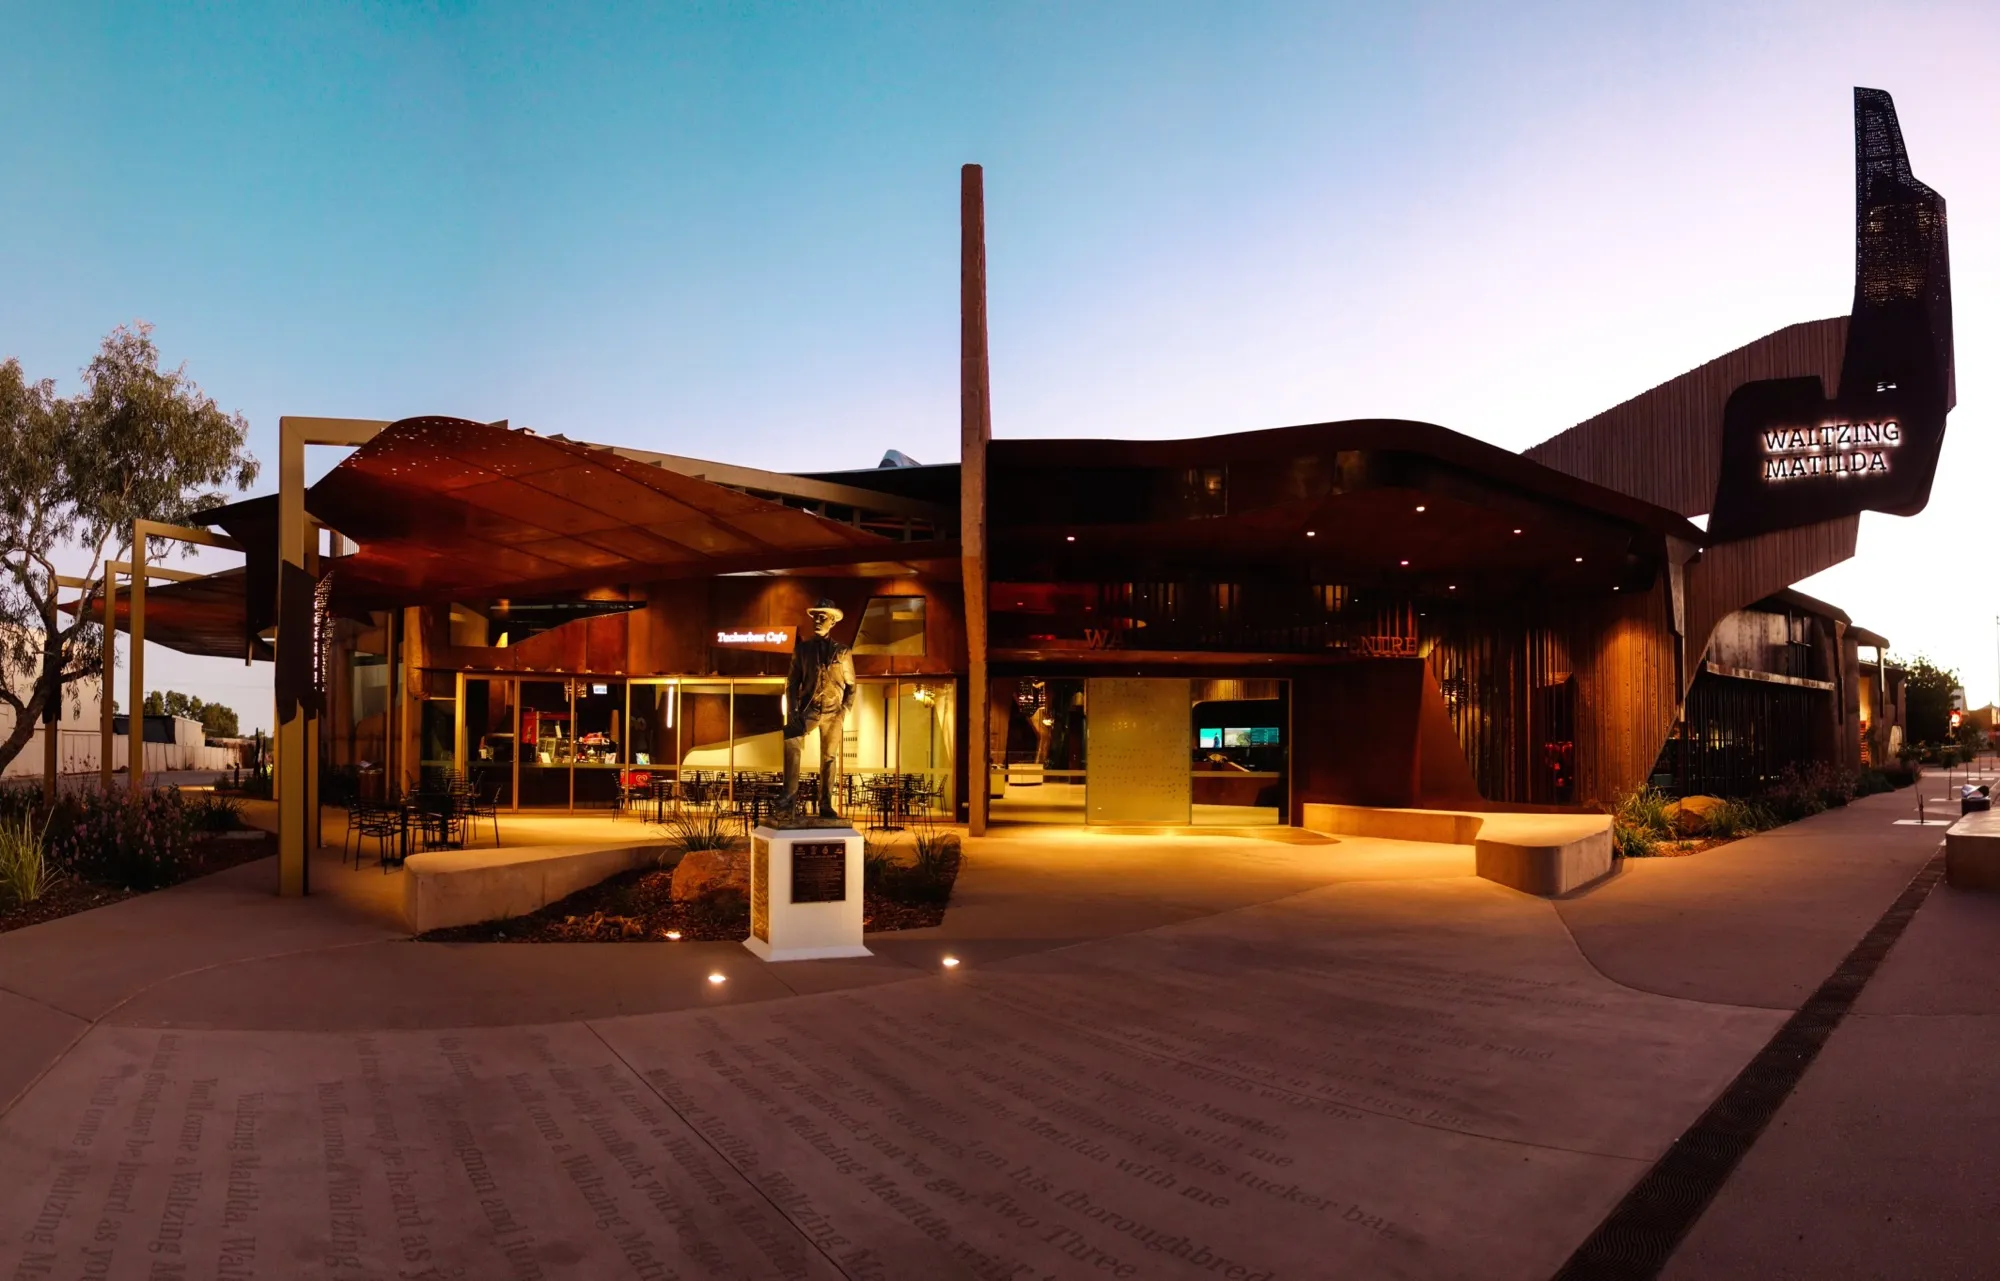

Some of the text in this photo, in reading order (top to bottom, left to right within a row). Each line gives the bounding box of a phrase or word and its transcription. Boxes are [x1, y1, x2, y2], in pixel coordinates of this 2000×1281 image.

[1763, 421, 1900, 450] WALTZING
[1764, 451, 1888, 479] MATILDA
[717, 631, 788, 645] Tuckerbox Cafe
[72, 1107, 105, 1148] come
[124, 1137, 156, 1159] be
[178, 1109, 205, 1152] come
[526, 1103, 565, 1142] come
[561, 1153, 631, 1232] Waltzing
[664, 1135, 741, 1206] Waltzing
[784, 1114, 869, 1176] Waltzing
[860, 1170, 952, 1243] Matilda
[974, 1149, 1009, 1170] on
[1007, 1165, 1054, 1193] his
[1115, 1156, 1178, 1189] with
[1178, 1184, 1232, 1211] me
[1185, 1151, 1232, 1176] his
[1235, 1170, 1339, 1212] tucker
[1246, 1148, 1295, 1168] me
[20, 1163, 92, 1246] Waltzing
[102, 1161, 150, 1215] heard
[147, 1171, 204, 1255] Waltzing
[220, 1154, 262, 1230] Matilda,
[757, 1169, 852, 1252] Waltzing
[93, 1217, 123, 1243] as
[323, 1174, 368, 1269] Waltzing
[480, 1198, 529, 1236] and
[981, 1190, 1041, 1229] Two
[1040, 1224, 1138, 1280] Three
[400, 1233, 433, 1264] as
